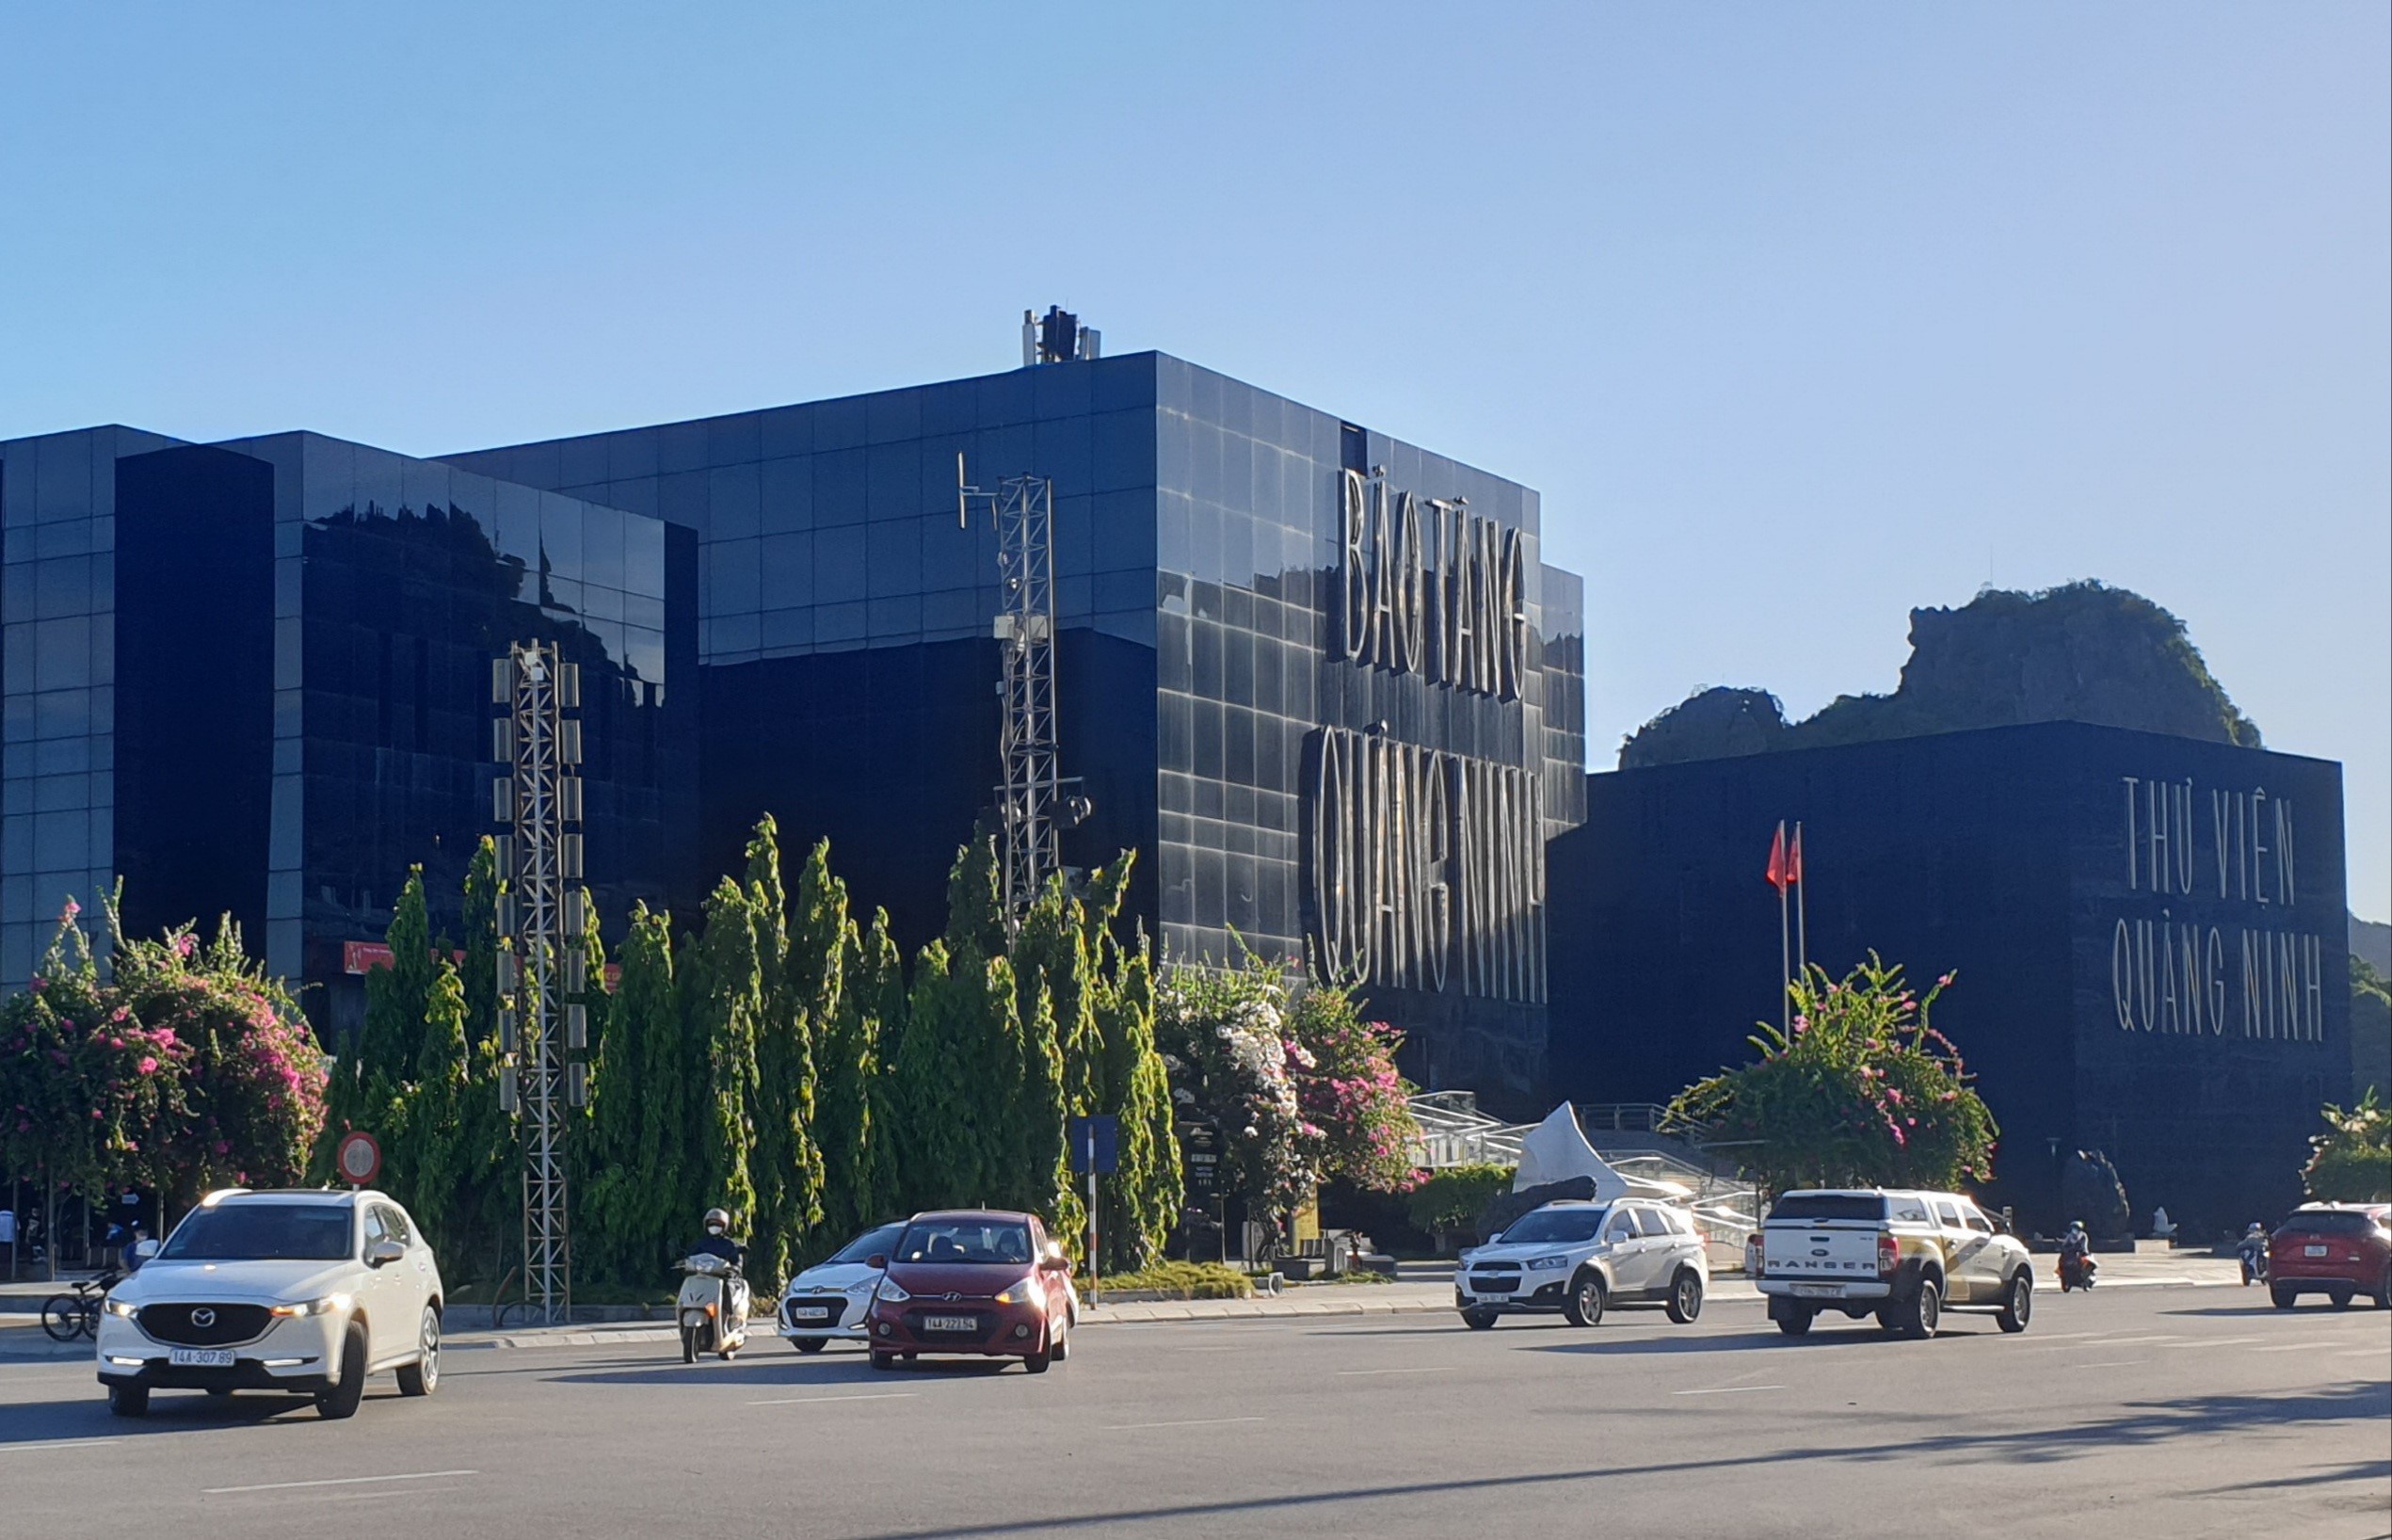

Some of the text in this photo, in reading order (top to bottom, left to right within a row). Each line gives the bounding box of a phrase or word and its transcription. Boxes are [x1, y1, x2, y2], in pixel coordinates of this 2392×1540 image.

[1460, 755, 1548, 1004] NINH
[2122, 777, 2295, 909] THƯ VIỆN
[2111, 908, 2322, 1042] QUẢNG NINH
[1768, 1260, 1875, 1270] RANGER
